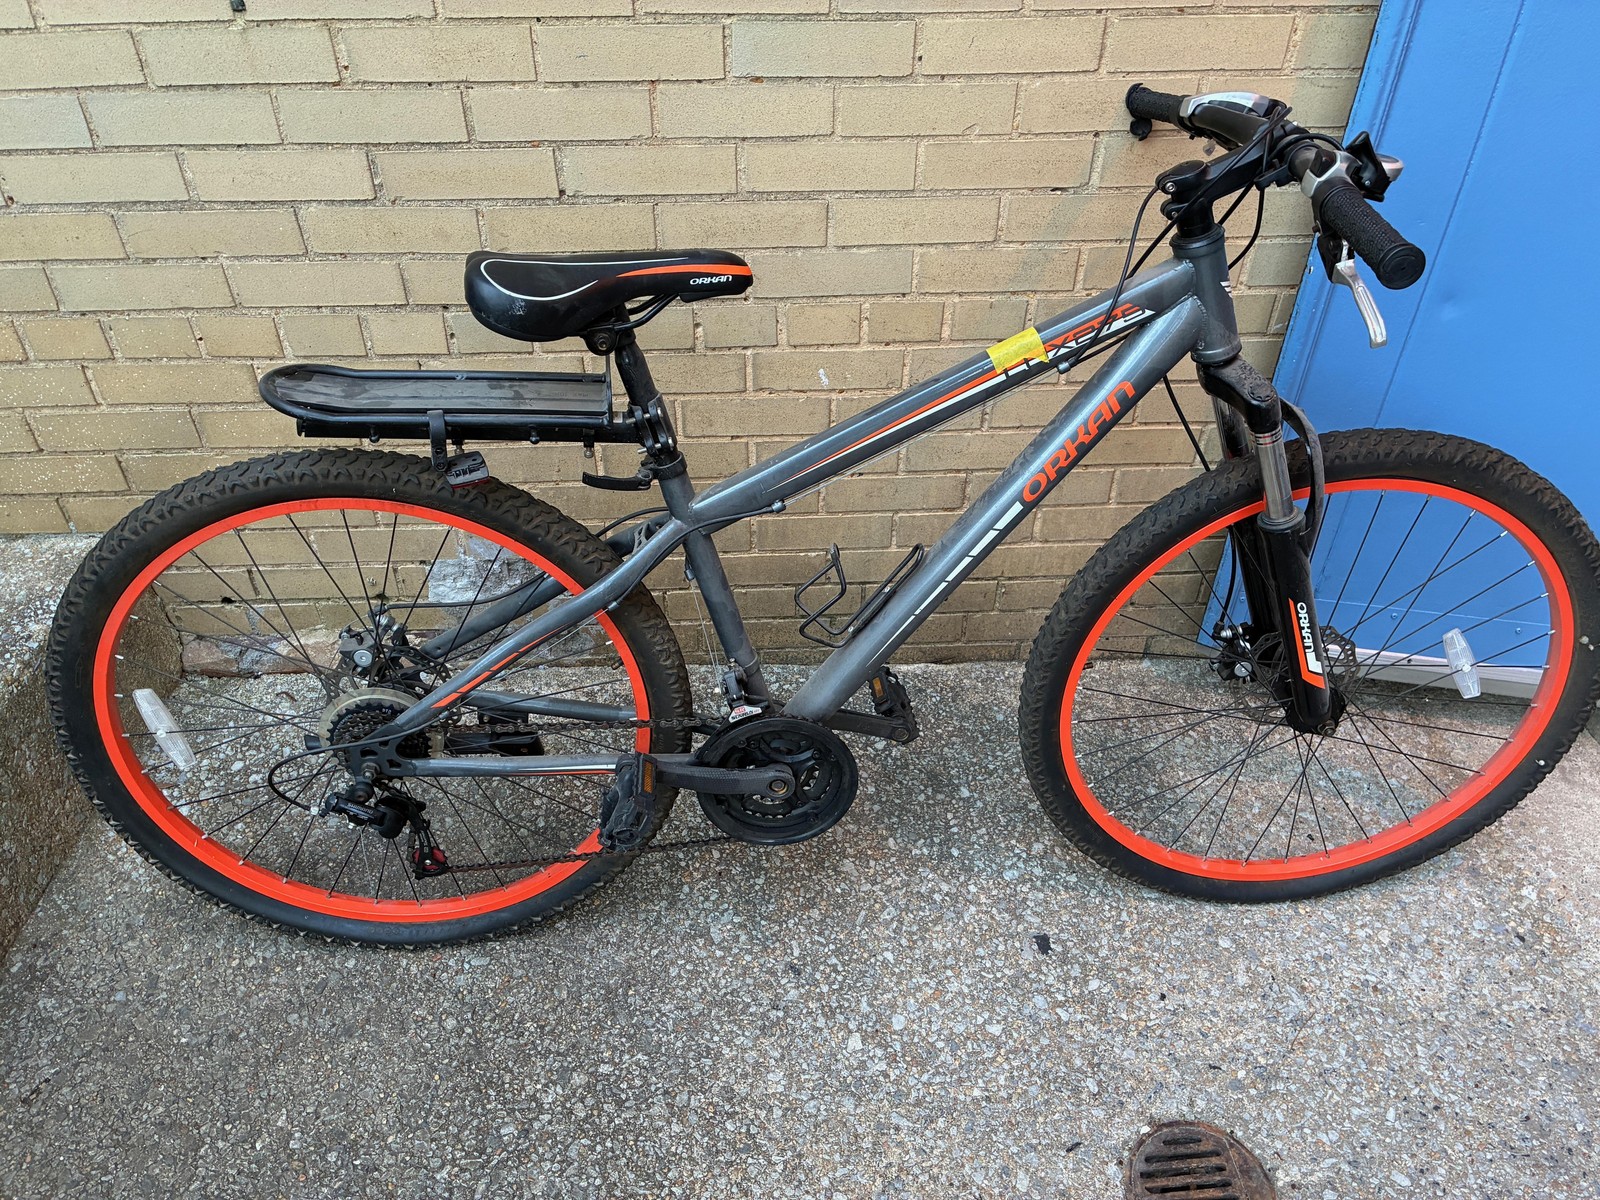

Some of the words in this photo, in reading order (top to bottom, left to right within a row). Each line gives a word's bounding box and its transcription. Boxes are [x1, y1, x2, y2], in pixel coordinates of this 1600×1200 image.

[689, 274, 733, 285] ORKAN
[1022, 380, 1136, 502] ORKAN
[1297, 602, 1314, 653] ORKAN
